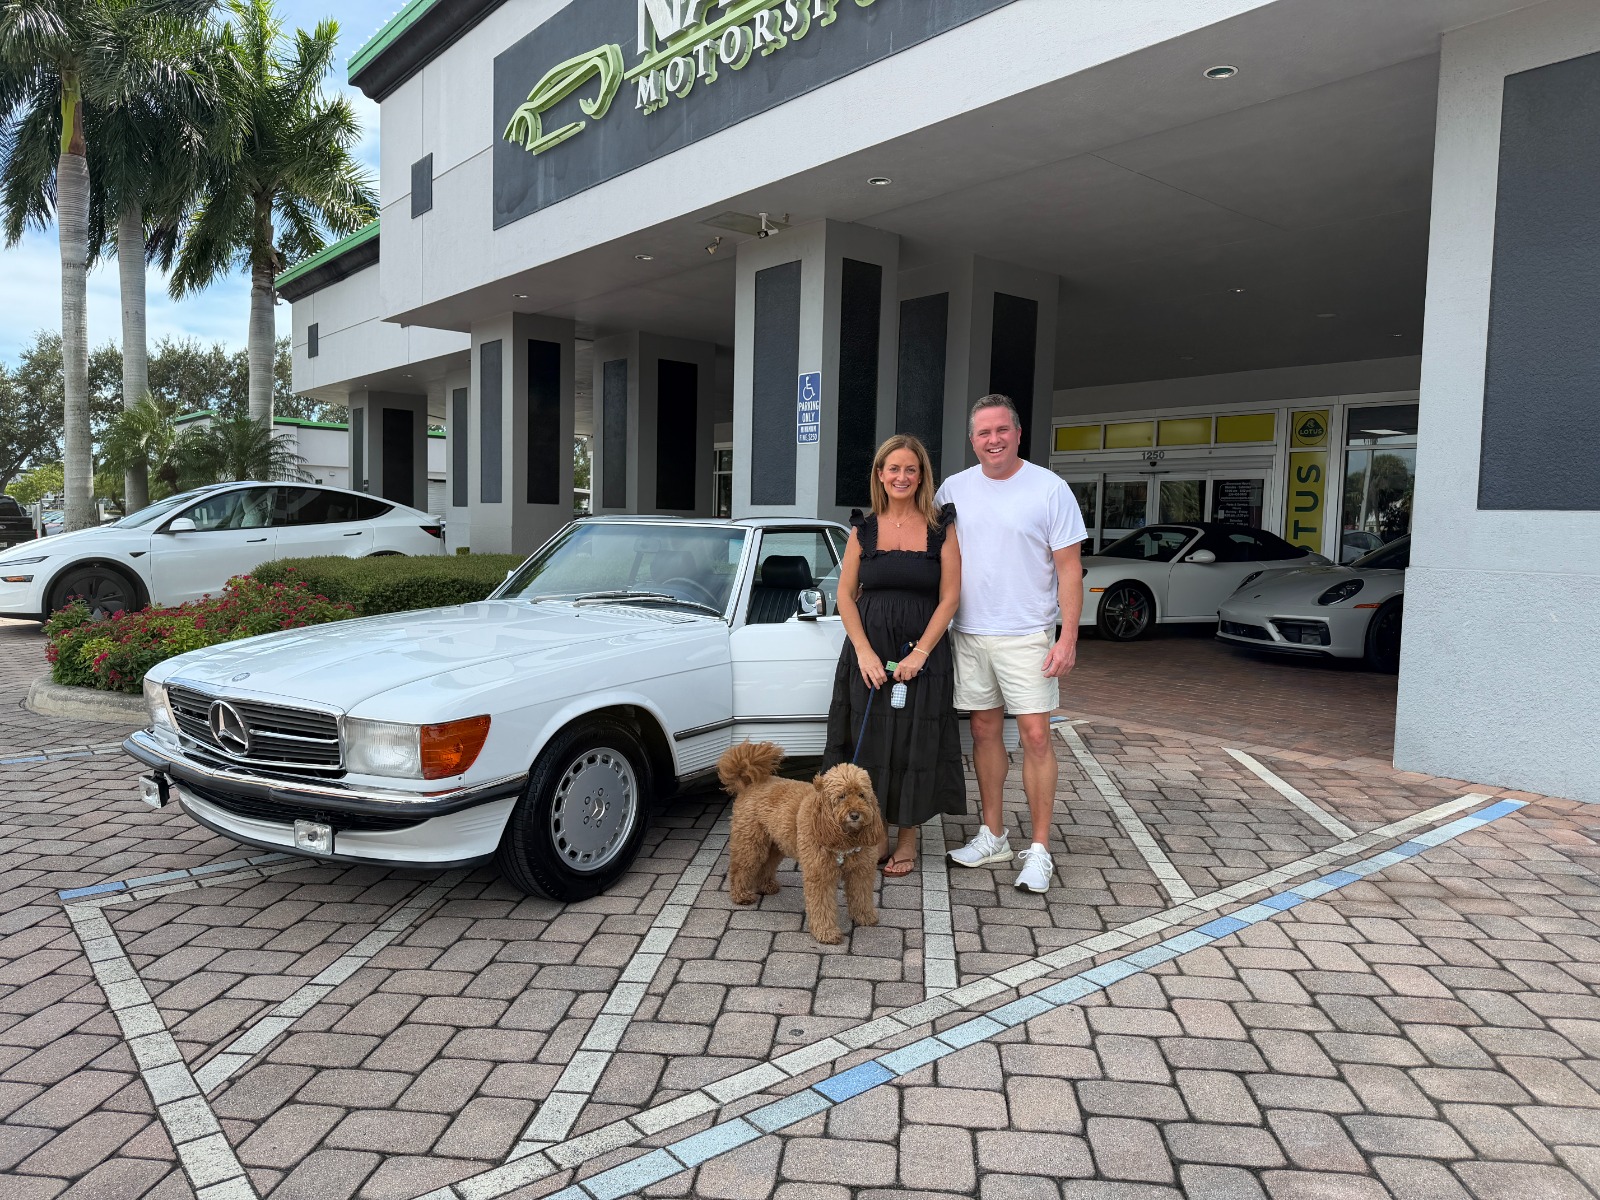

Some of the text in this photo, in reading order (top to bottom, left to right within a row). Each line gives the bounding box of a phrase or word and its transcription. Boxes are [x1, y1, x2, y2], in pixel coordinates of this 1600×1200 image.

[799, 400, 819, 411] PARKING
[802, 412, 815, 423] ONLY
[1141, 451, 1165, 461] 1250
[1293, 464, 1321, 552] TUS
